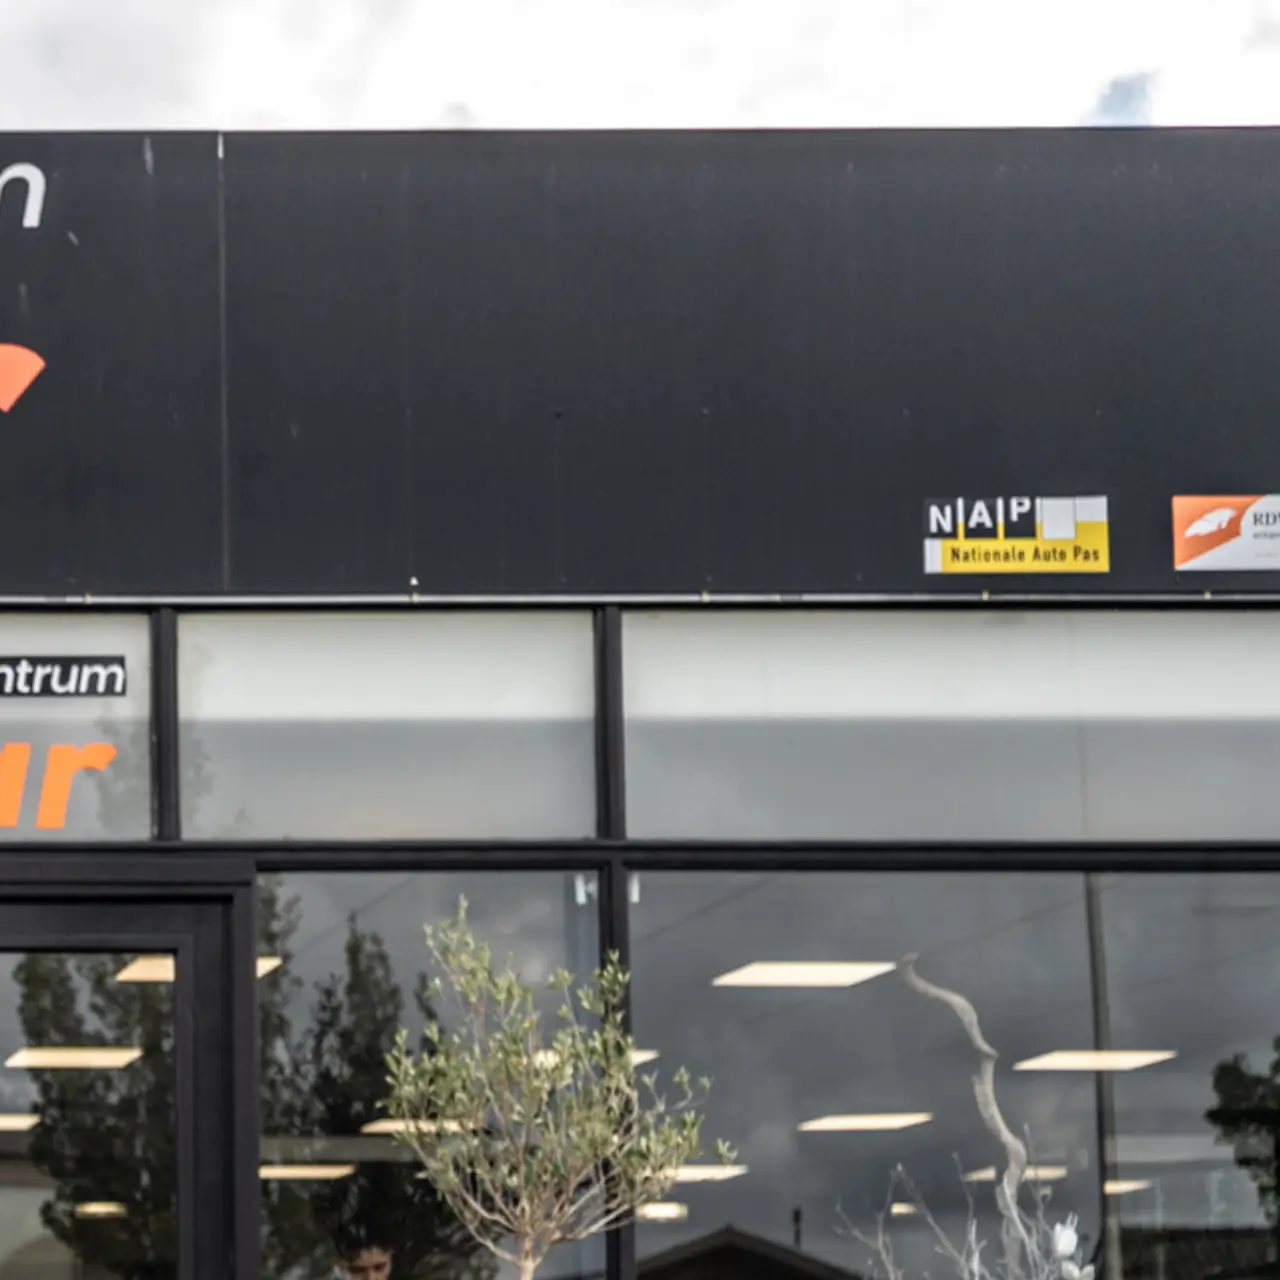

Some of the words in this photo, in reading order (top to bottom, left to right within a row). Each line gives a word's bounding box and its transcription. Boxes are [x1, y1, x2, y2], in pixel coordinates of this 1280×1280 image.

[1252, 512, 1280, 526] RD
[951, 546, 1025, 563] Nationale
[1033, 546, 1067, 562] Auto
[1073, 546, 1100, 562] Pas
